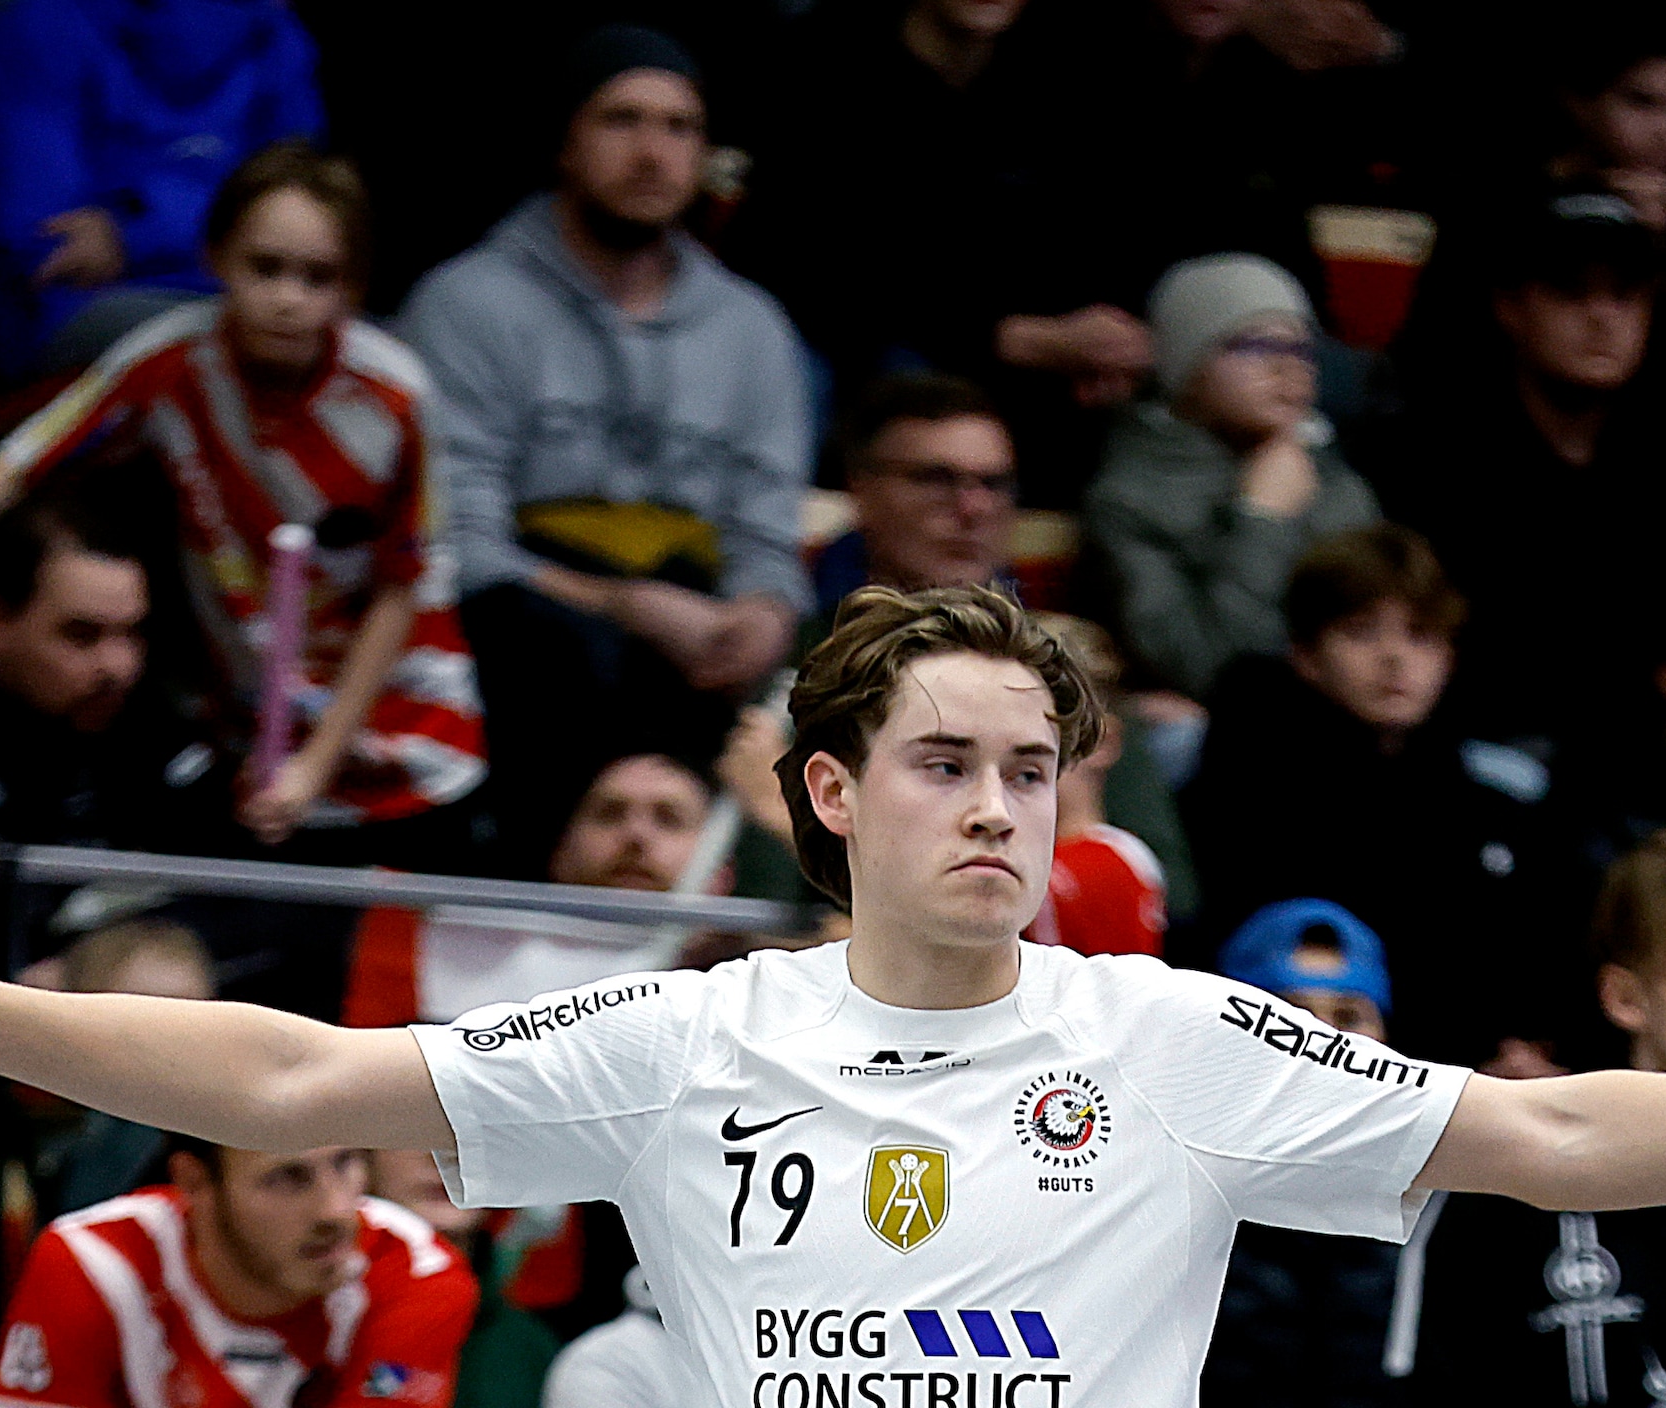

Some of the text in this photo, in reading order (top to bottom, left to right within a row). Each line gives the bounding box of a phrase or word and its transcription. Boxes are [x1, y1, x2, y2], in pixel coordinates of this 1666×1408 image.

[1220, 995, 1429, 1088] stadium
[1014, 1070, 1112, 1146] STORVRETA INNEBANDY
[1033, 1149, 1099, 1169] UPPSALA
[1038, 1177, 1094, 1193] #GUTS
[724, 1151, 815, 1248] 79
[755, 1309, 886, 1359] BYGG
